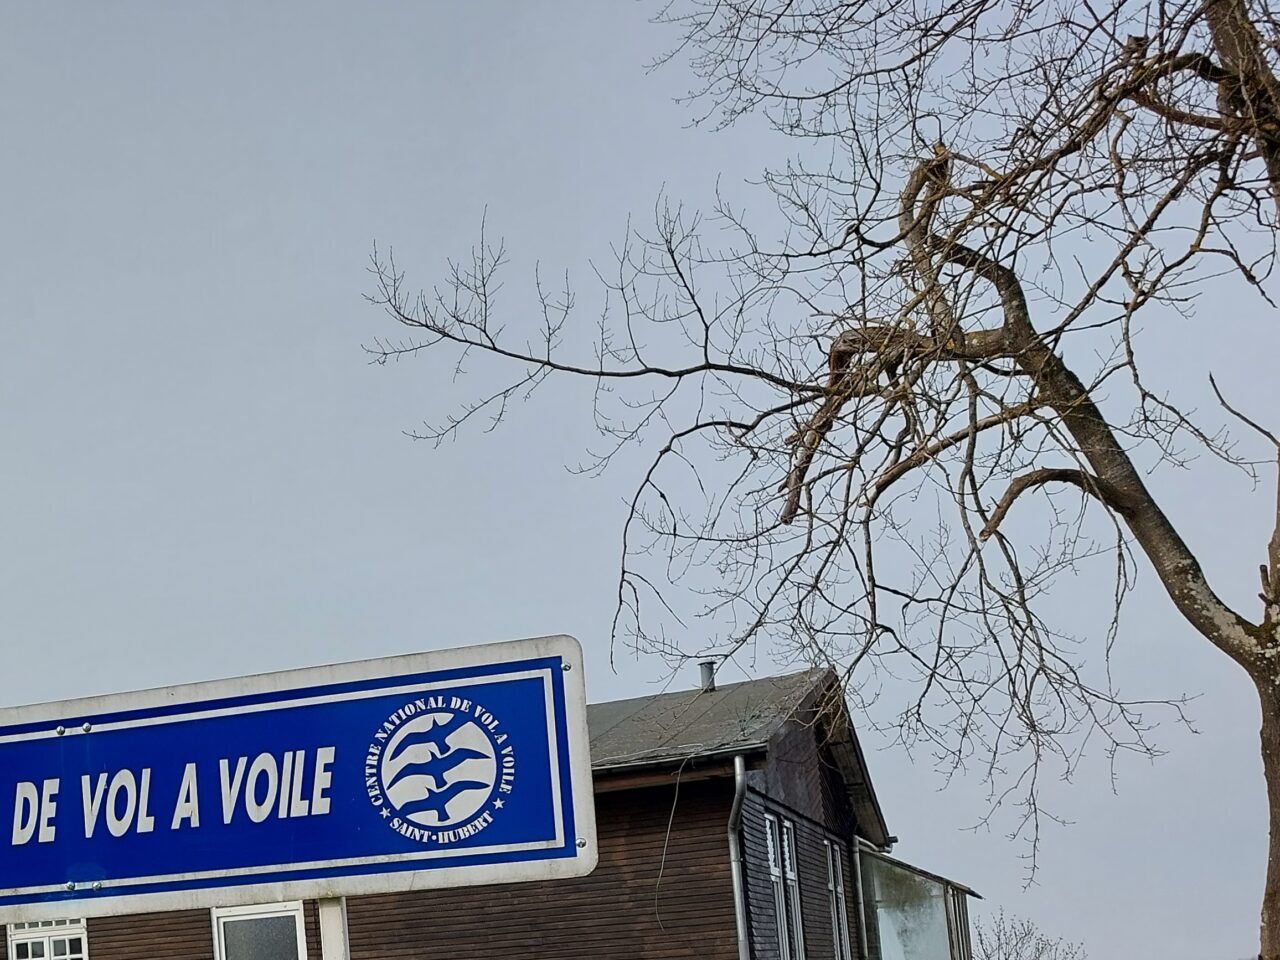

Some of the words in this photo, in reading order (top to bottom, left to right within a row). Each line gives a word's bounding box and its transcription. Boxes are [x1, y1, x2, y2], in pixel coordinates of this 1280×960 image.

[374, 696, 446, 743] NATIONAL
[450, 697, 472, 712] DE
[474, 705, 500, 733] VOL
[494, 734, 508, 744] A
[365, 743, 384, 806] CENTRE
[499, 746, 515, 794] VOILE
[11, 778, 60, 845] DE
[81, 768, 154, 838] VOL
[171, 763, 200, 830] A
[219, 746, 336, 824] VOILE
